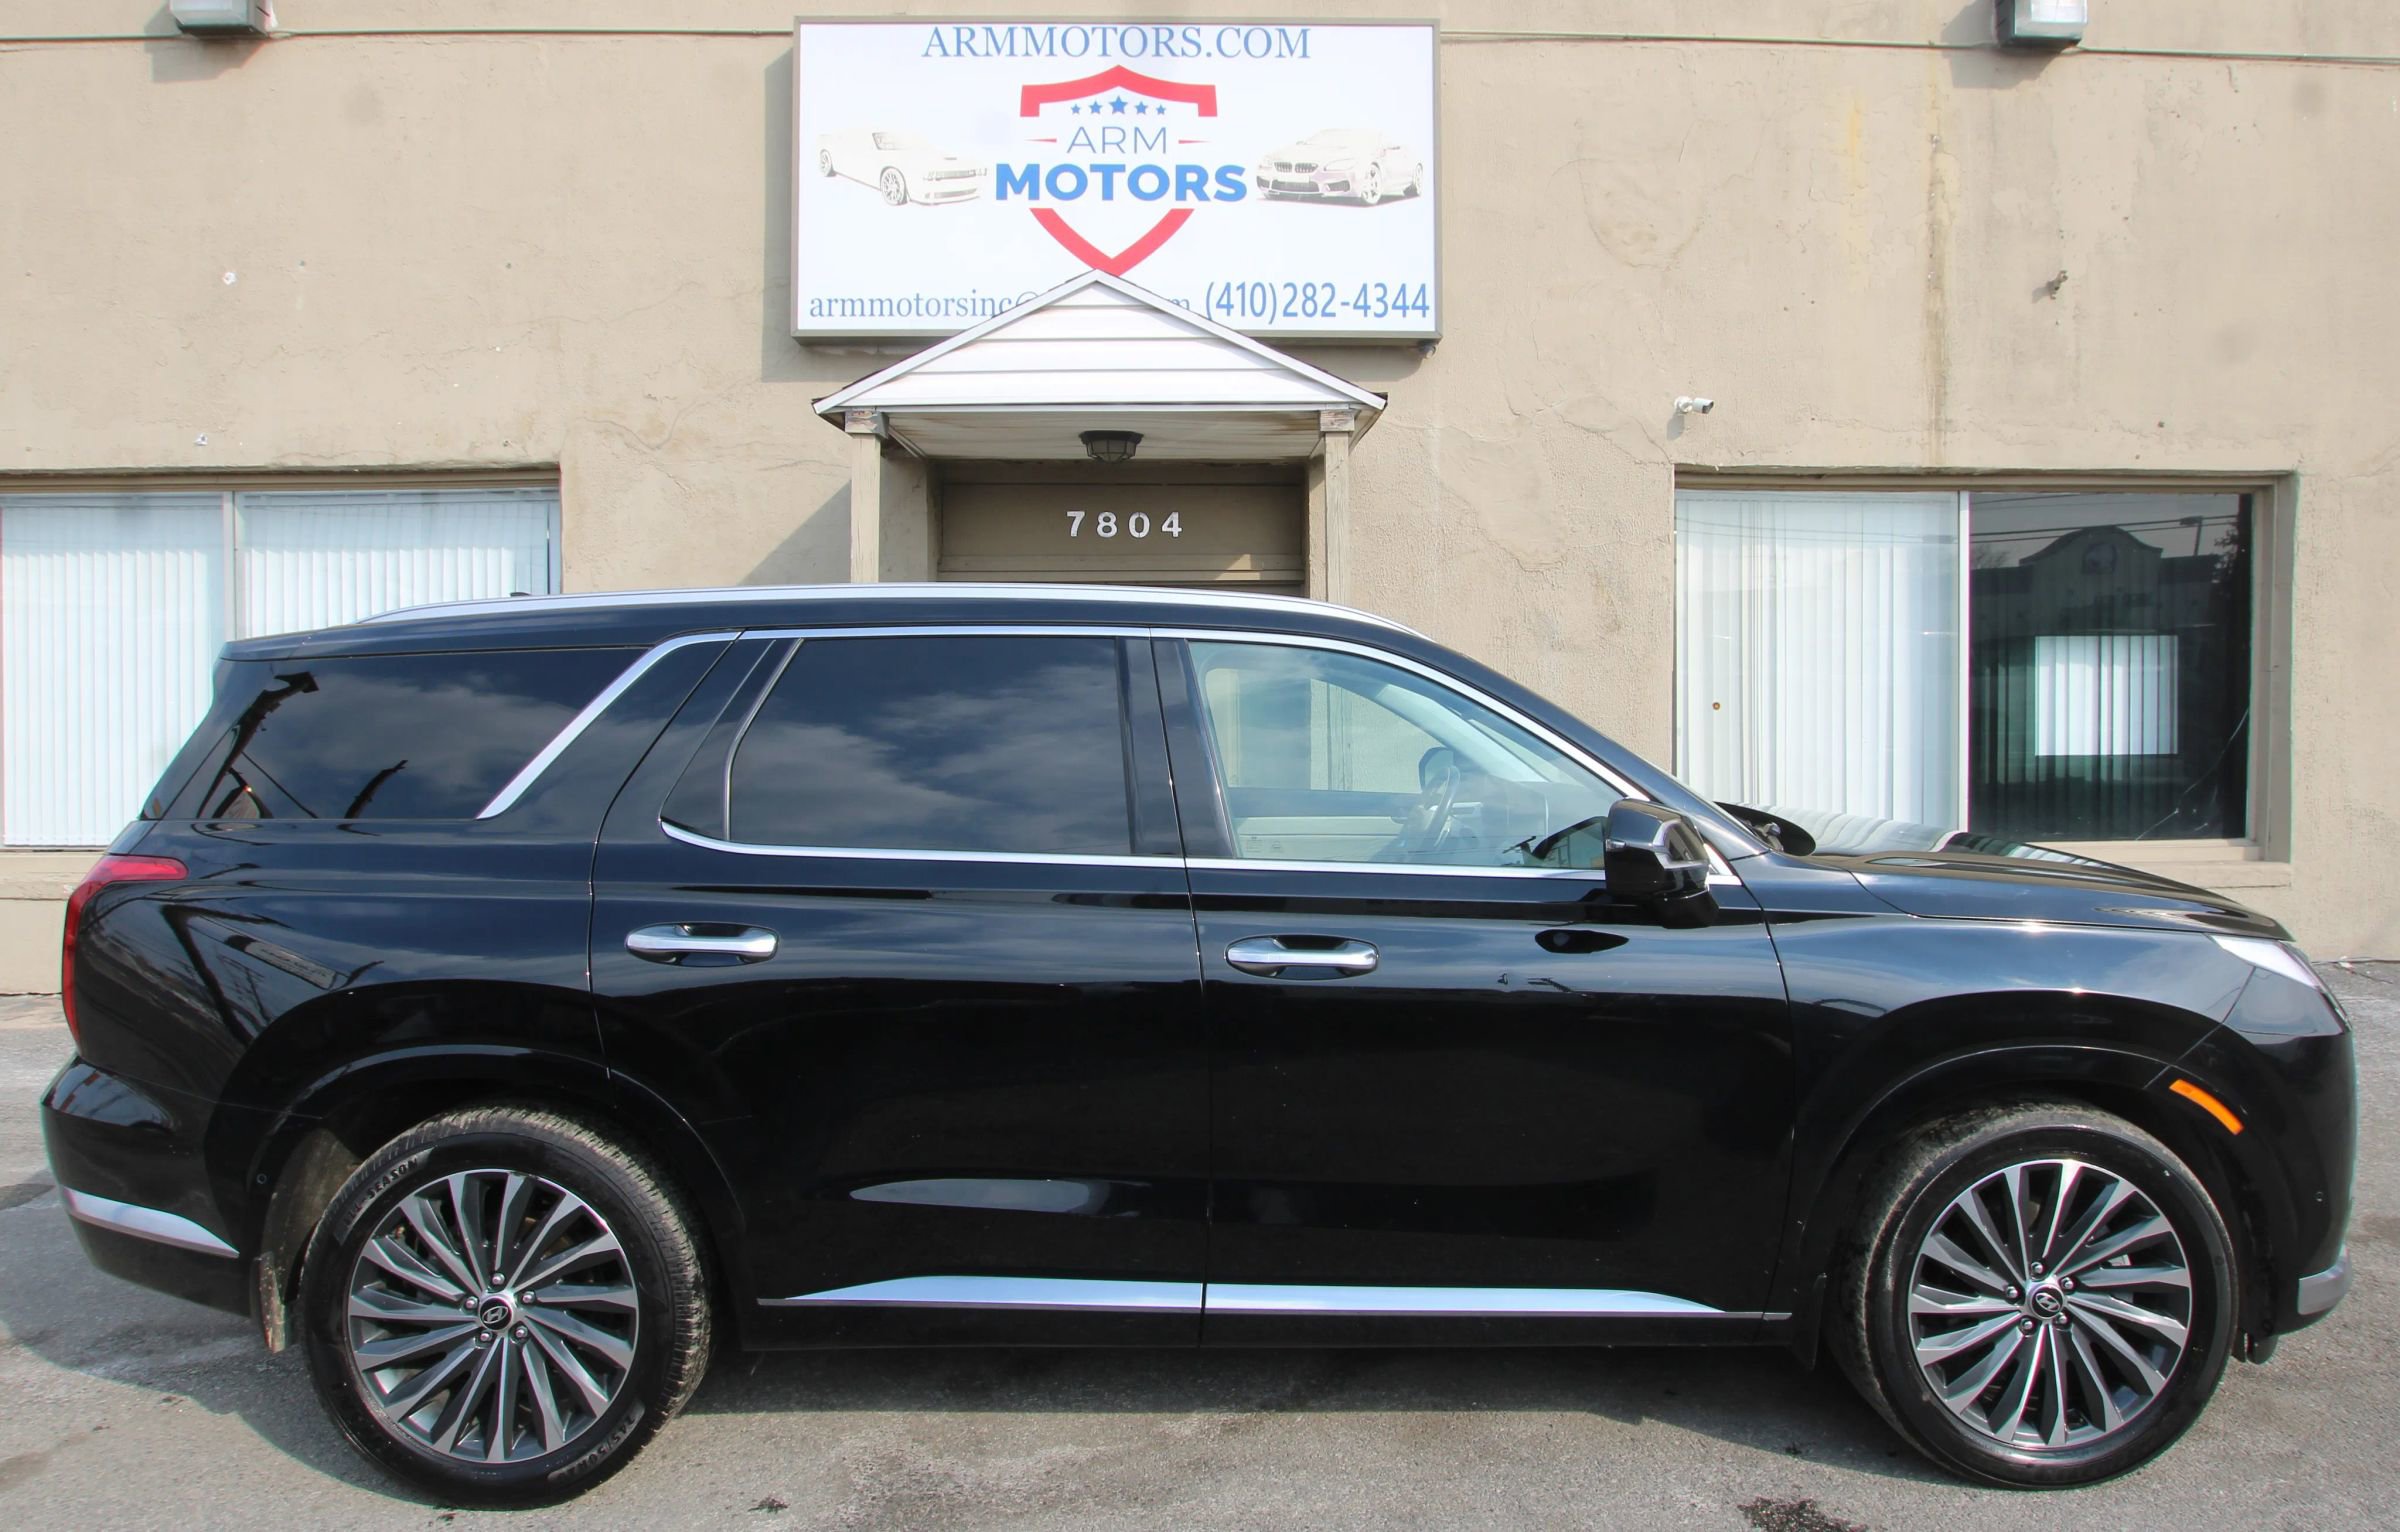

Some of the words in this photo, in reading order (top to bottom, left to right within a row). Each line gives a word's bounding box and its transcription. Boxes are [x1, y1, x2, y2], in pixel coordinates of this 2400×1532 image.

[921, 26, 1312, 59] ARMMOTORS.COM
[1066, 126, 1168, 154] ARM
[995, 163, 1248, 202] MOTORS
[1206, 281, 1430, 324] (410)282-4344
[1066, 510, 1183, 539] 7804
